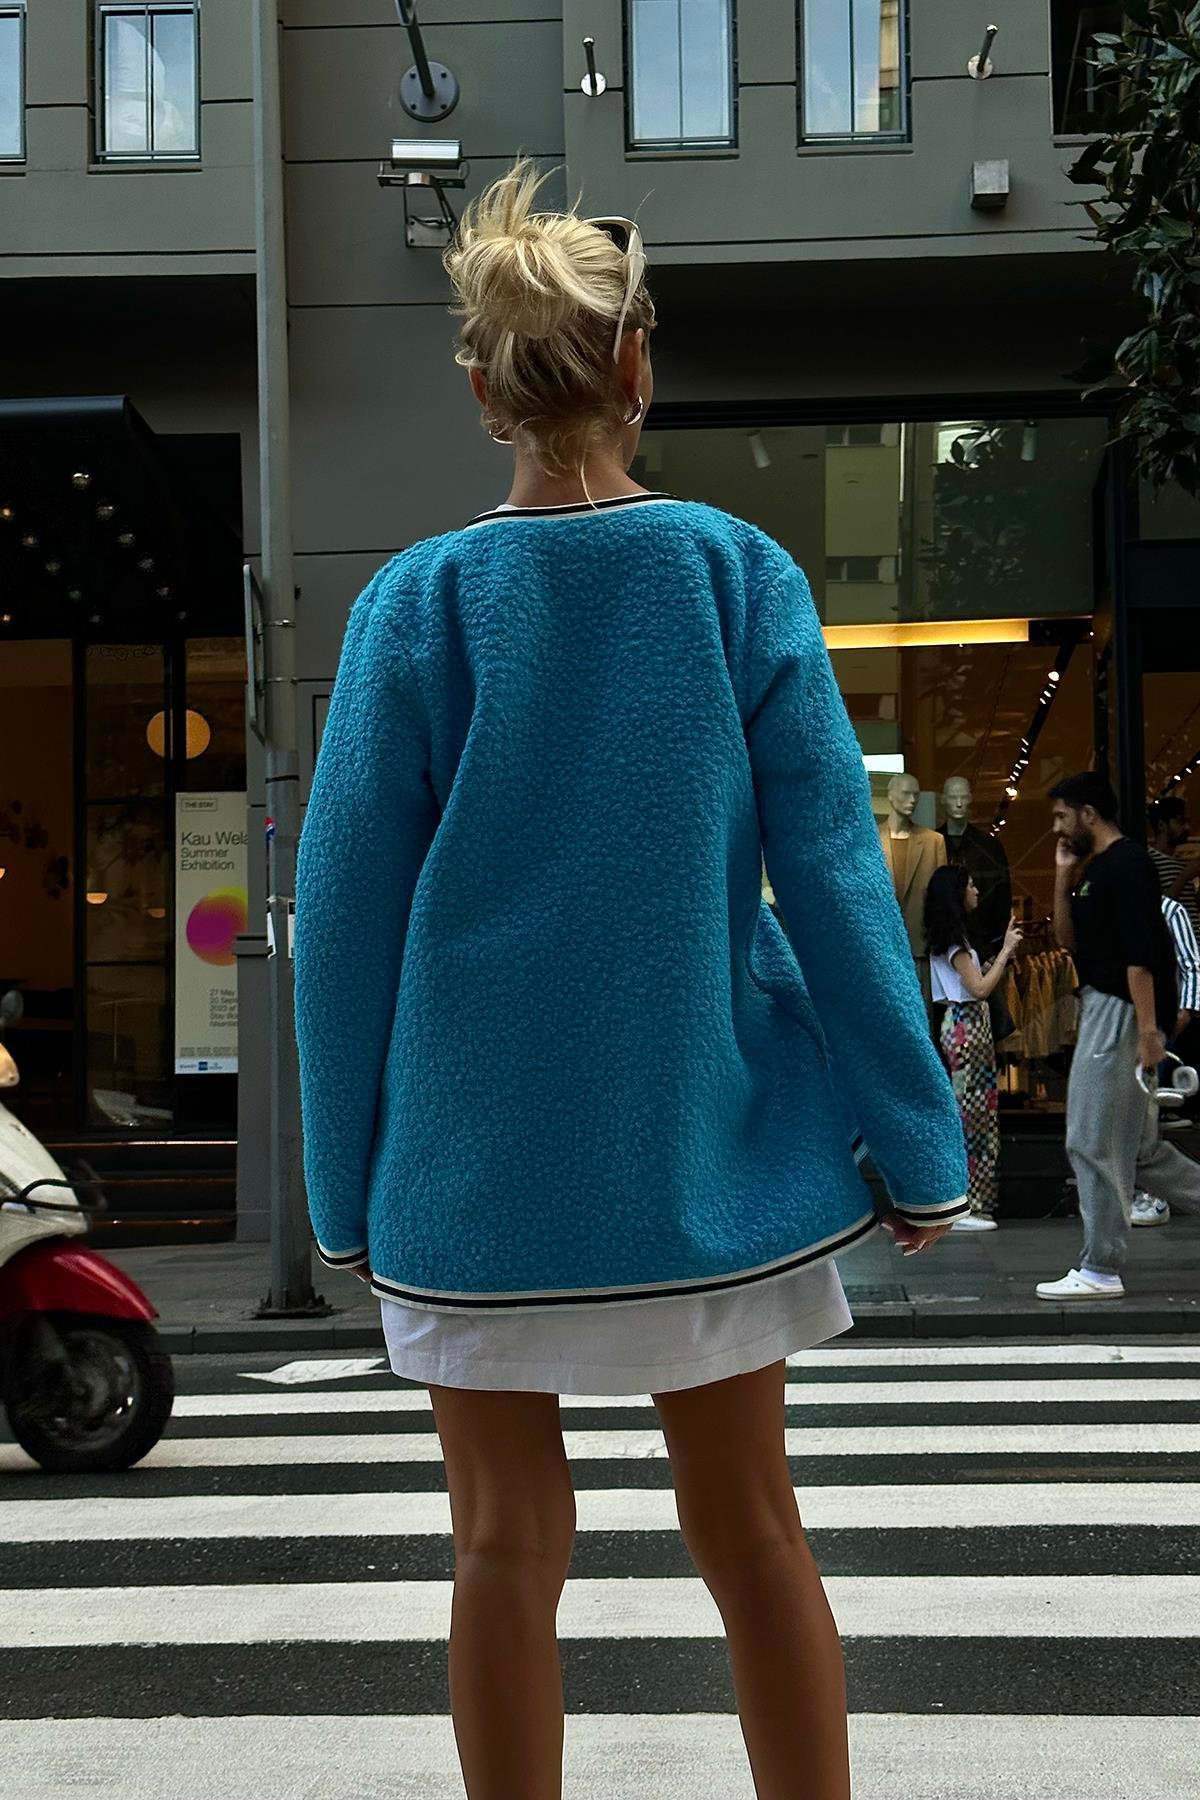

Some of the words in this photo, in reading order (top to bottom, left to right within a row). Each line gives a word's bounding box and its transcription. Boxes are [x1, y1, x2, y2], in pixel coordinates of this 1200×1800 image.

[181, 831, 211, 846] Kau
[181, 847, 229, 859] Summer
[181, 859, 234, 871] Exhibition
